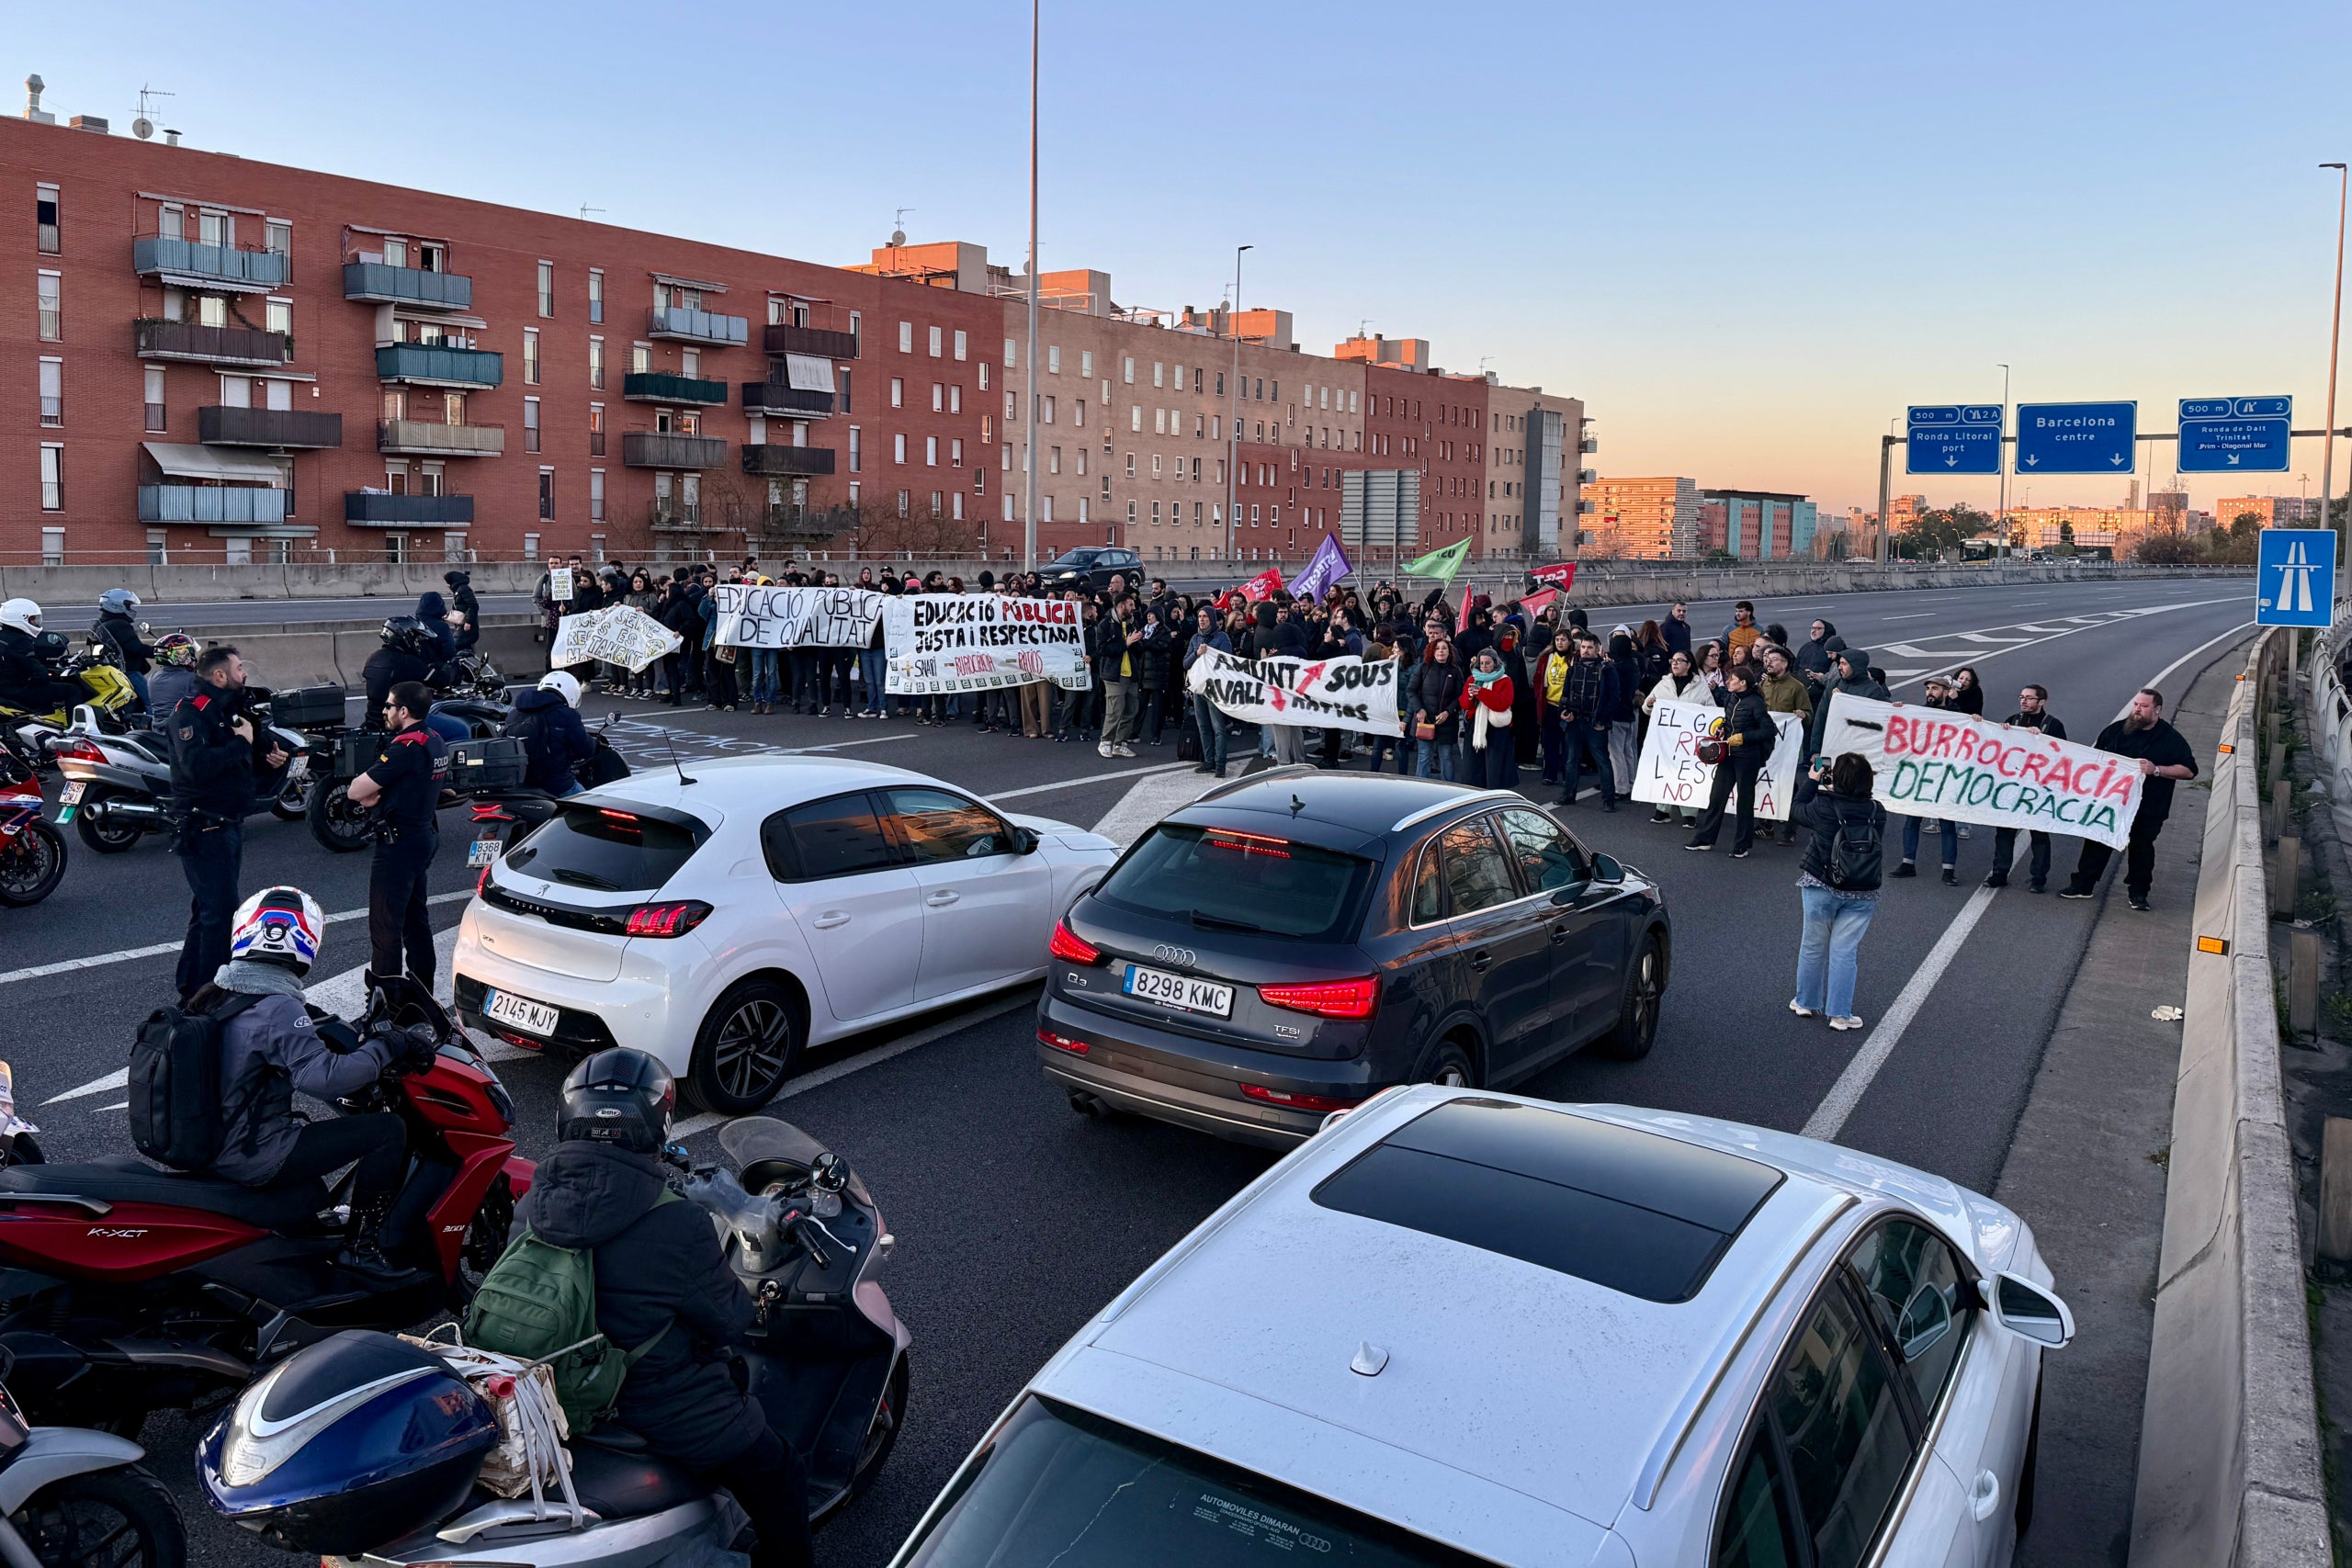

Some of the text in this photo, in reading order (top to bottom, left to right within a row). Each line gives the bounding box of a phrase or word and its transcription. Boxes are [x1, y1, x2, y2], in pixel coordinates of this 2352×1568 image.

[1982, 411, 1998, 419] 2 A
[2276, 402, 2283, 411] 2
[2036, 416, 2115, 428] Barcelona
[1917, 432, 1992, 441] Ronda Litoral
[2054, 433, 2095, 441] centre
[1941, 444, 1965, 454] port
[716, 586, 804, 619] EDUCACIÓ
[914, 597, 995, 627] EDUCACIÓ
[1002, 600, 1077, 625] PÚBLICA
[740, 617, 771, 645] DE
[780, 615, 872, 647] QUALITAT
[915, 627, 967, 654] JUSTA
[979, 624, 1080, 647] RESPECTADA
[1214, 653, 1395, 693] AMUNT SOUS
[1204, 677, 1265, 705] AVALL
[1657, 707, 1682, 728] EL
[1883, 714, 2134, 807] BURROCRÀCIA
[1662, 782, 1693, 802] NO
[1888, 761, 2115, 833] DEMOCRÀCIA
[477, 841, 500, 852] 8368
[475, 852, 493, 863] KTM
[1068, 972, 1088, 987] Q3
[1136, 972, 1227, 1010] 8298 KMC
[493, 995, 527, 1021] 2145
[527, 1005, 557, 1031] MJY
[1273, 1024, 1300, 1035] TFSI
[87, 1227, 149, 1238] K-XCT
[1200, 1493, 1260, 1520] AUTOMOVILES
[1260, 1514, 1301, 1536] DIMARAN
